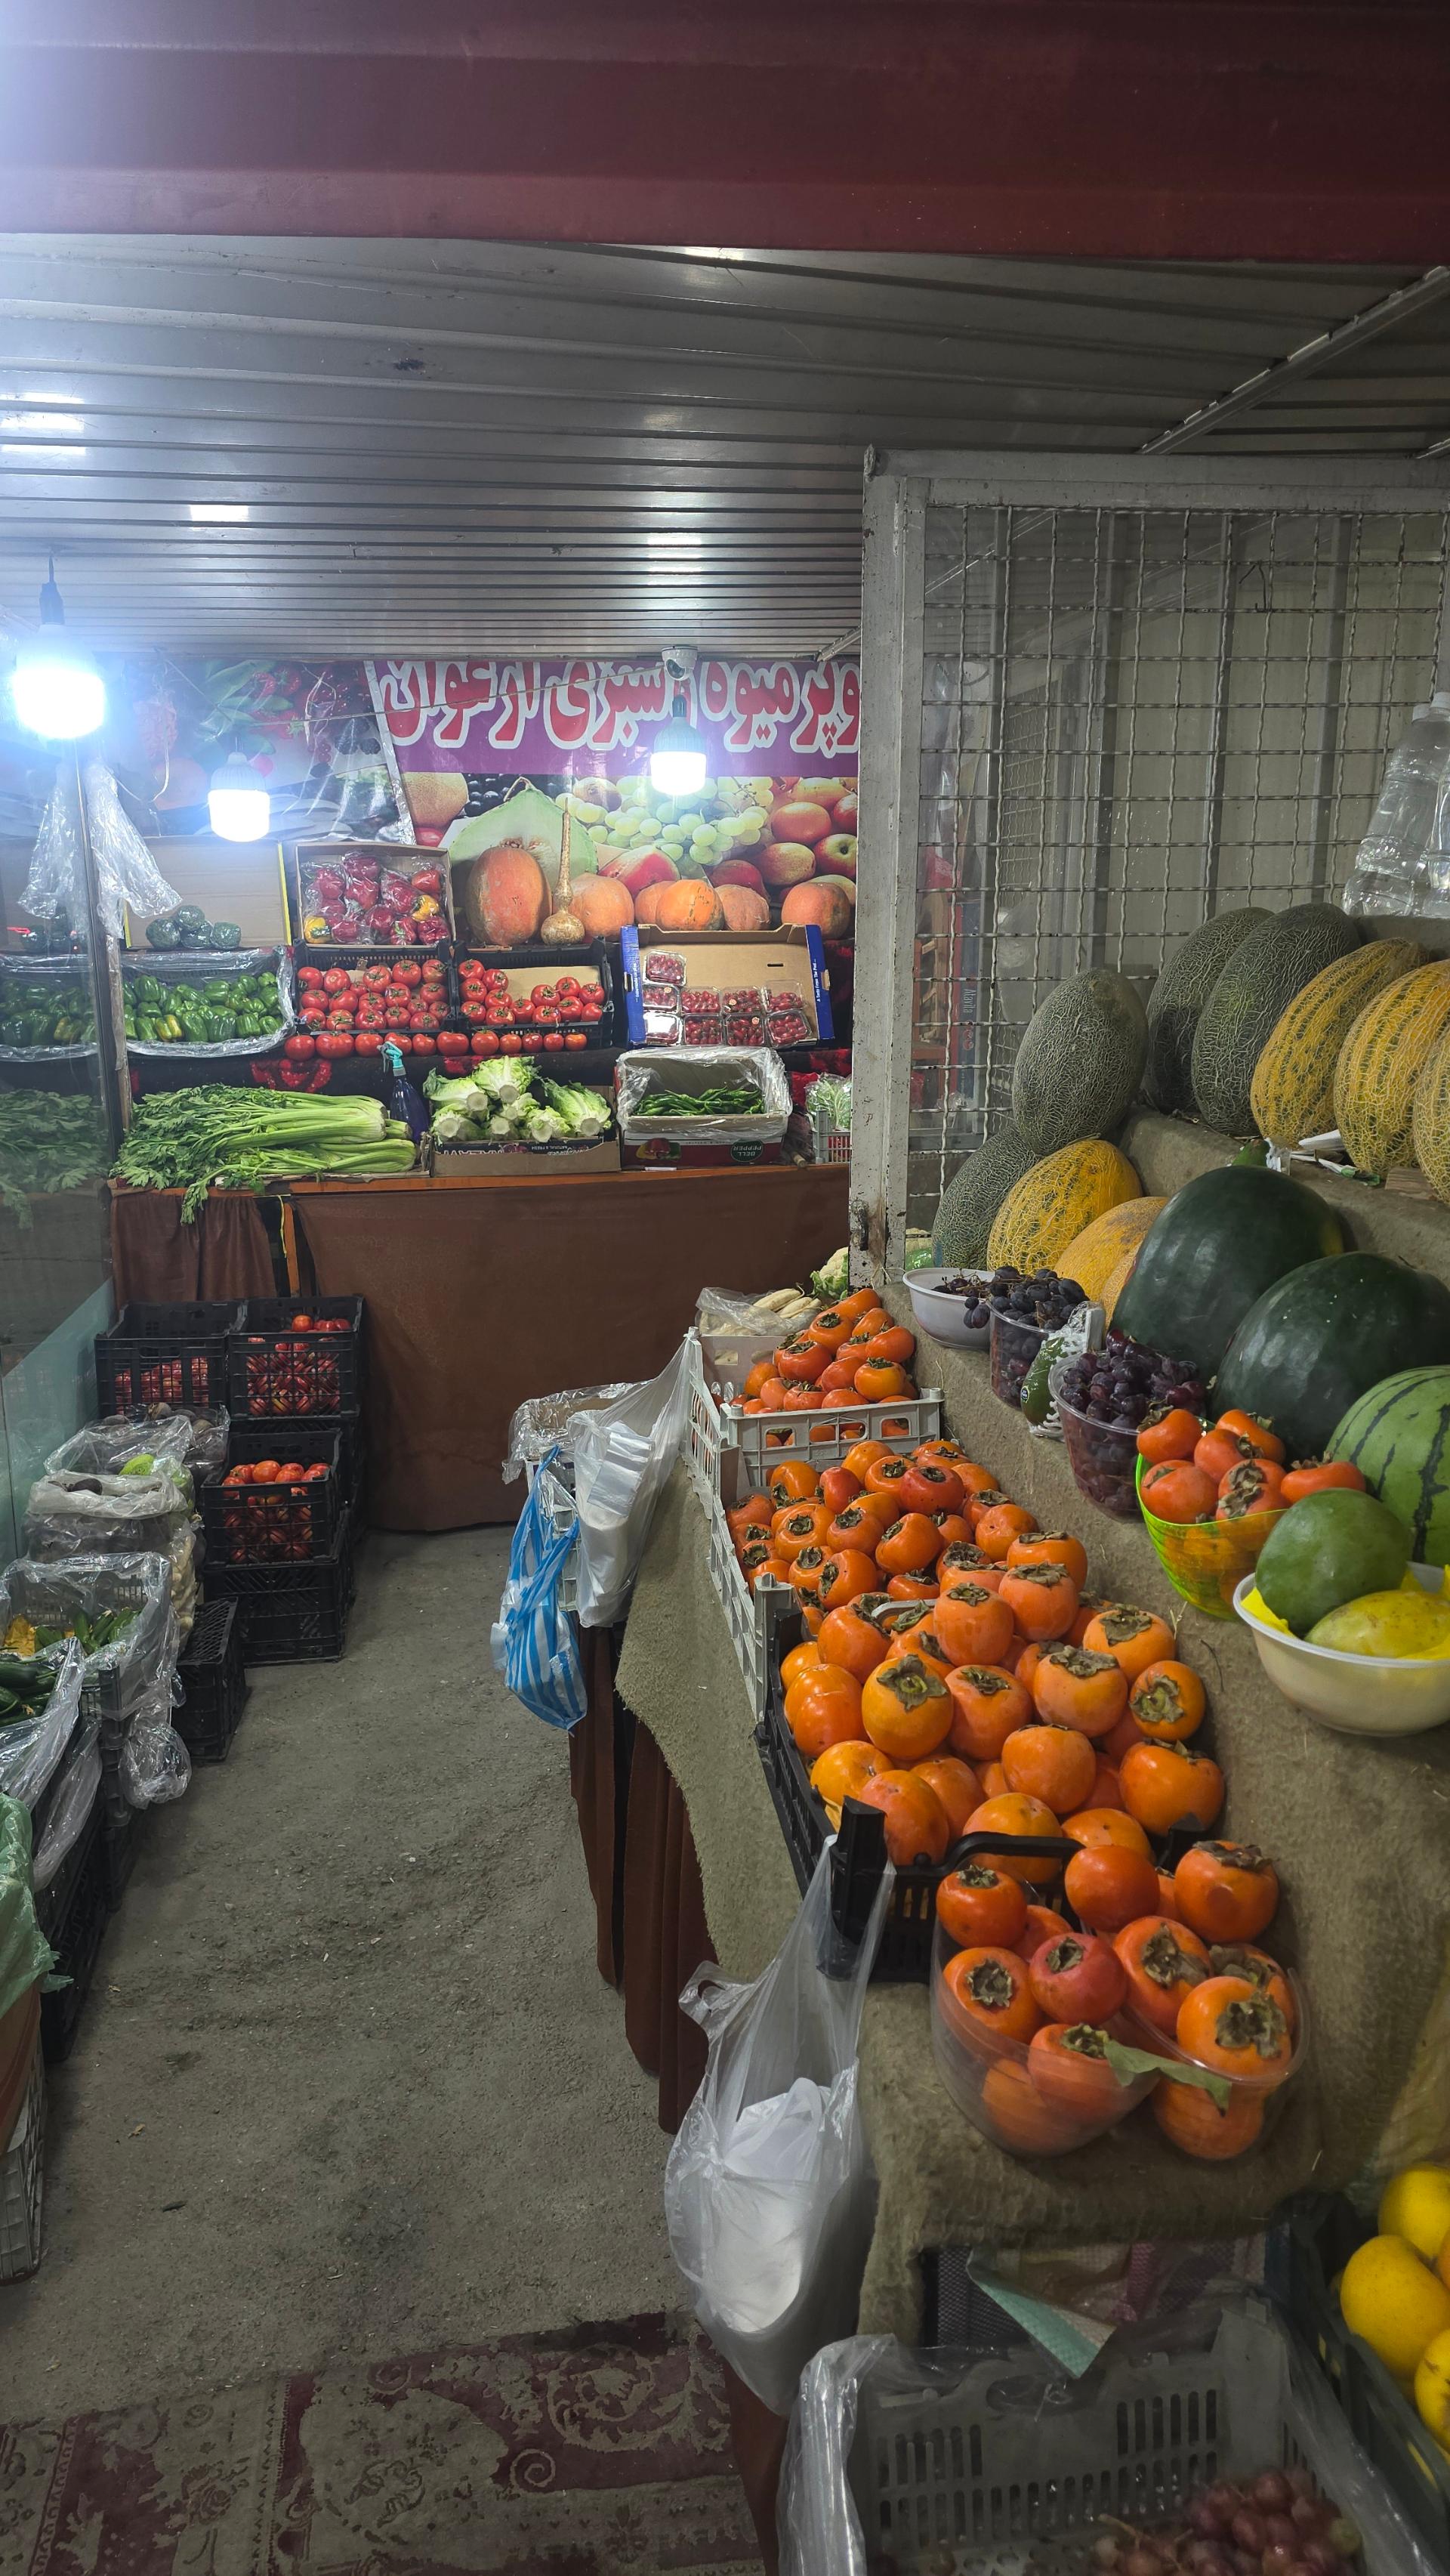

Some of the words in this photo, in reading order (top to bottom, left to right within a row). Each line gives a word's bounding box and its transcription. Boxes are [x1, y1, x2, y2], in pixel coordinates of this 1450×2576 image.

[544, 661, 671, 750] سبزی
[699, 662, 800, 752] میوه
[790, 662, 859, 758] وپر
[963, 988, 976, 1013] Atavila
